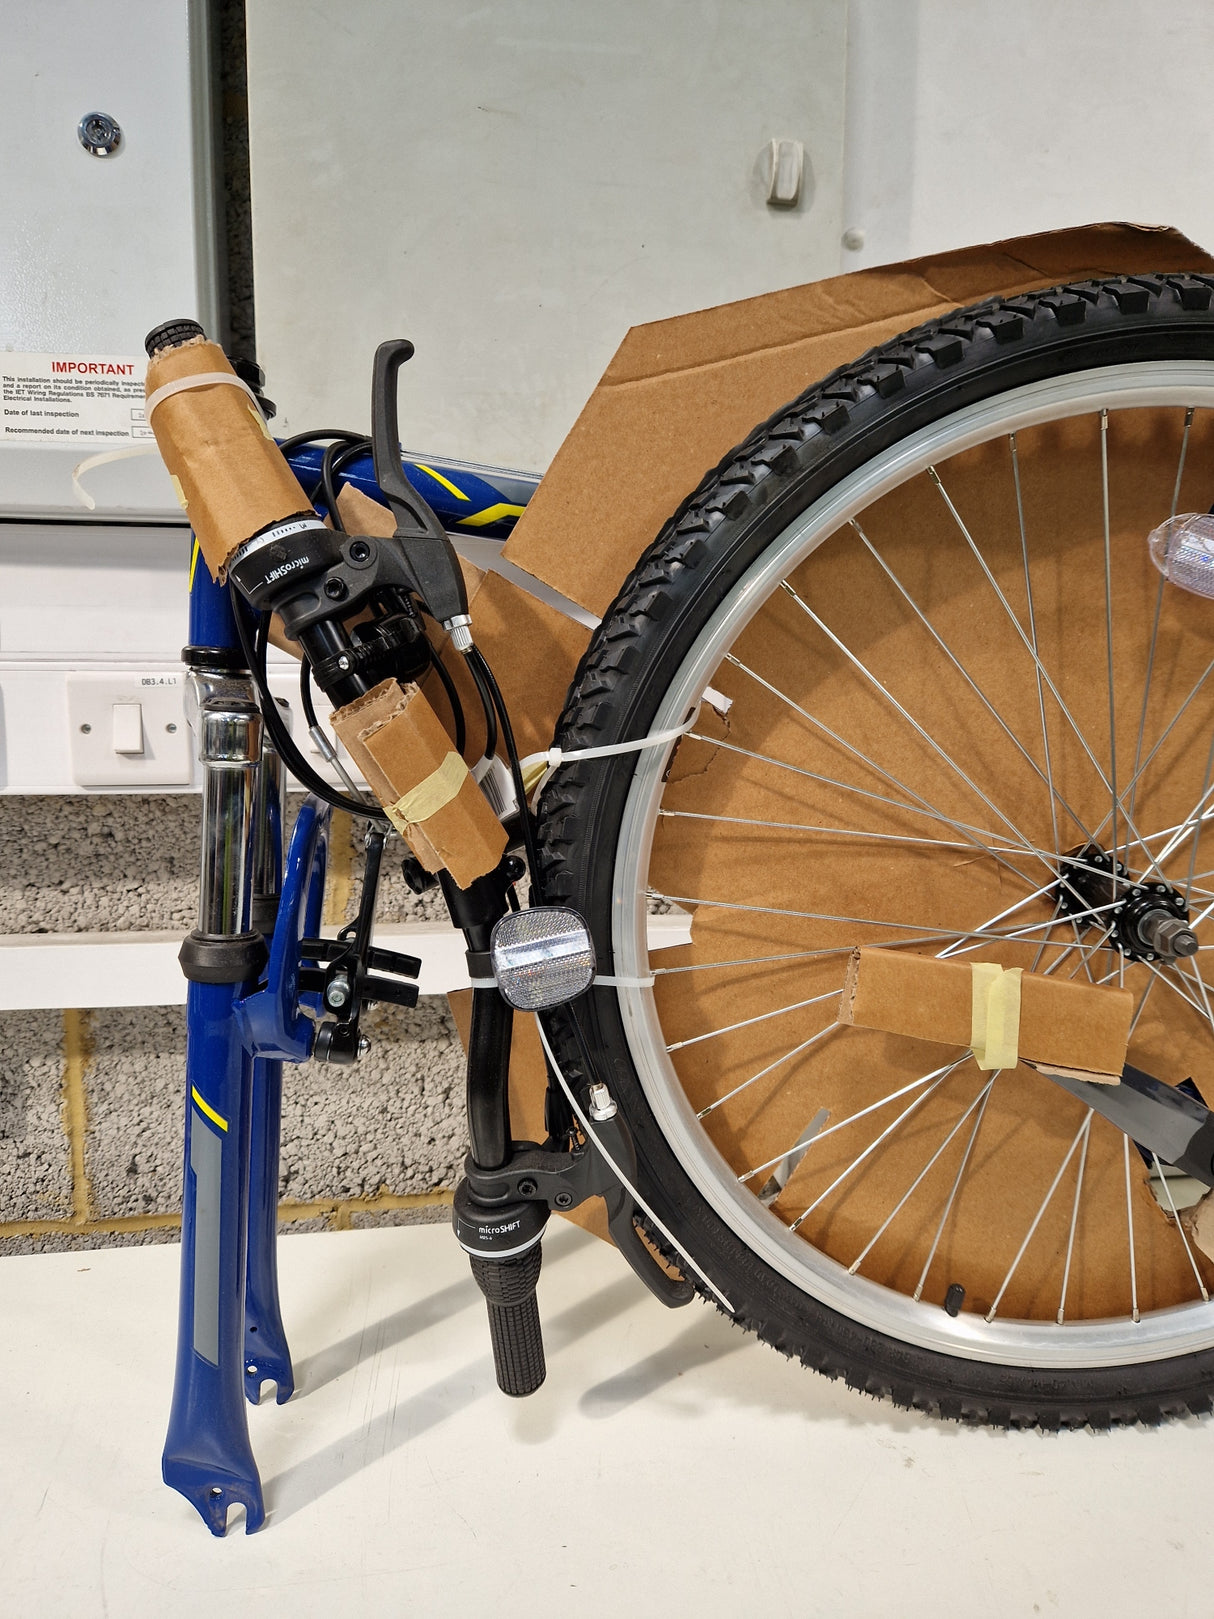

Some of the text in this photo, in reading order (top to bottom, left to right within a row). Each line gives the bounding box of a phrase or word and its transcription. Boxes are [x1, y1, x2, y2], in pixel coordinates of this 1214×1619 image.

[51, 361, 135, 376] IMPORTANT
[17, 376, 51, 384] installation
[84, 379, 119, 387] periodically
[26, 389, 47, 397] Wiring
[48, 390, 84, 398] Regulations
[5, 426, 54, 435] Recommended
[264, 556, 310, 584] microSHIFT
[478, 1219, 521, 1235] microSHIFT
